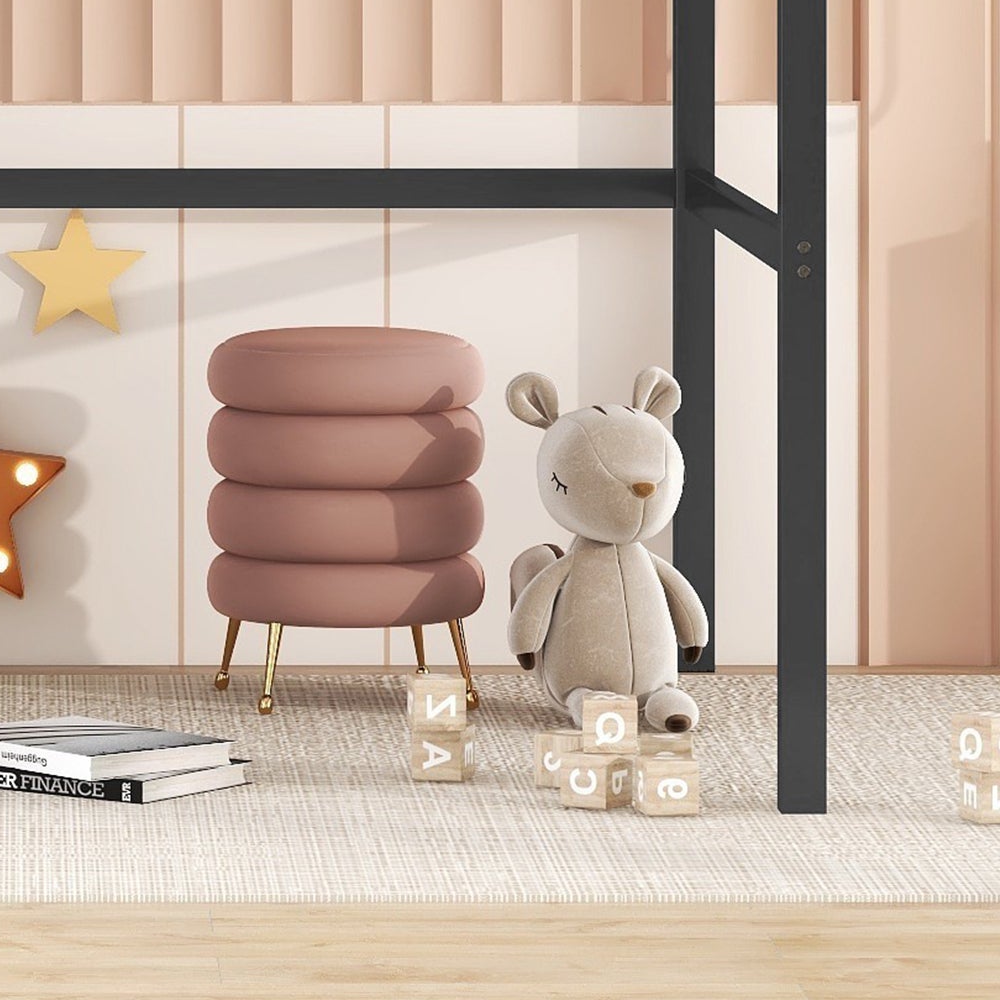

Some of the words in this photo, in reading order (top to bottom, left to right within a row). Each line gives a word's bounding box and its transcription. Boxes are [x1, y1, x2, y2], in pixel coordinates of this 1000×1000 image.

[2, 751, 48, 767] Guggenheim
[20, 774, 105, 797] FINANCE
[121, 782, 132, 802] EVR
